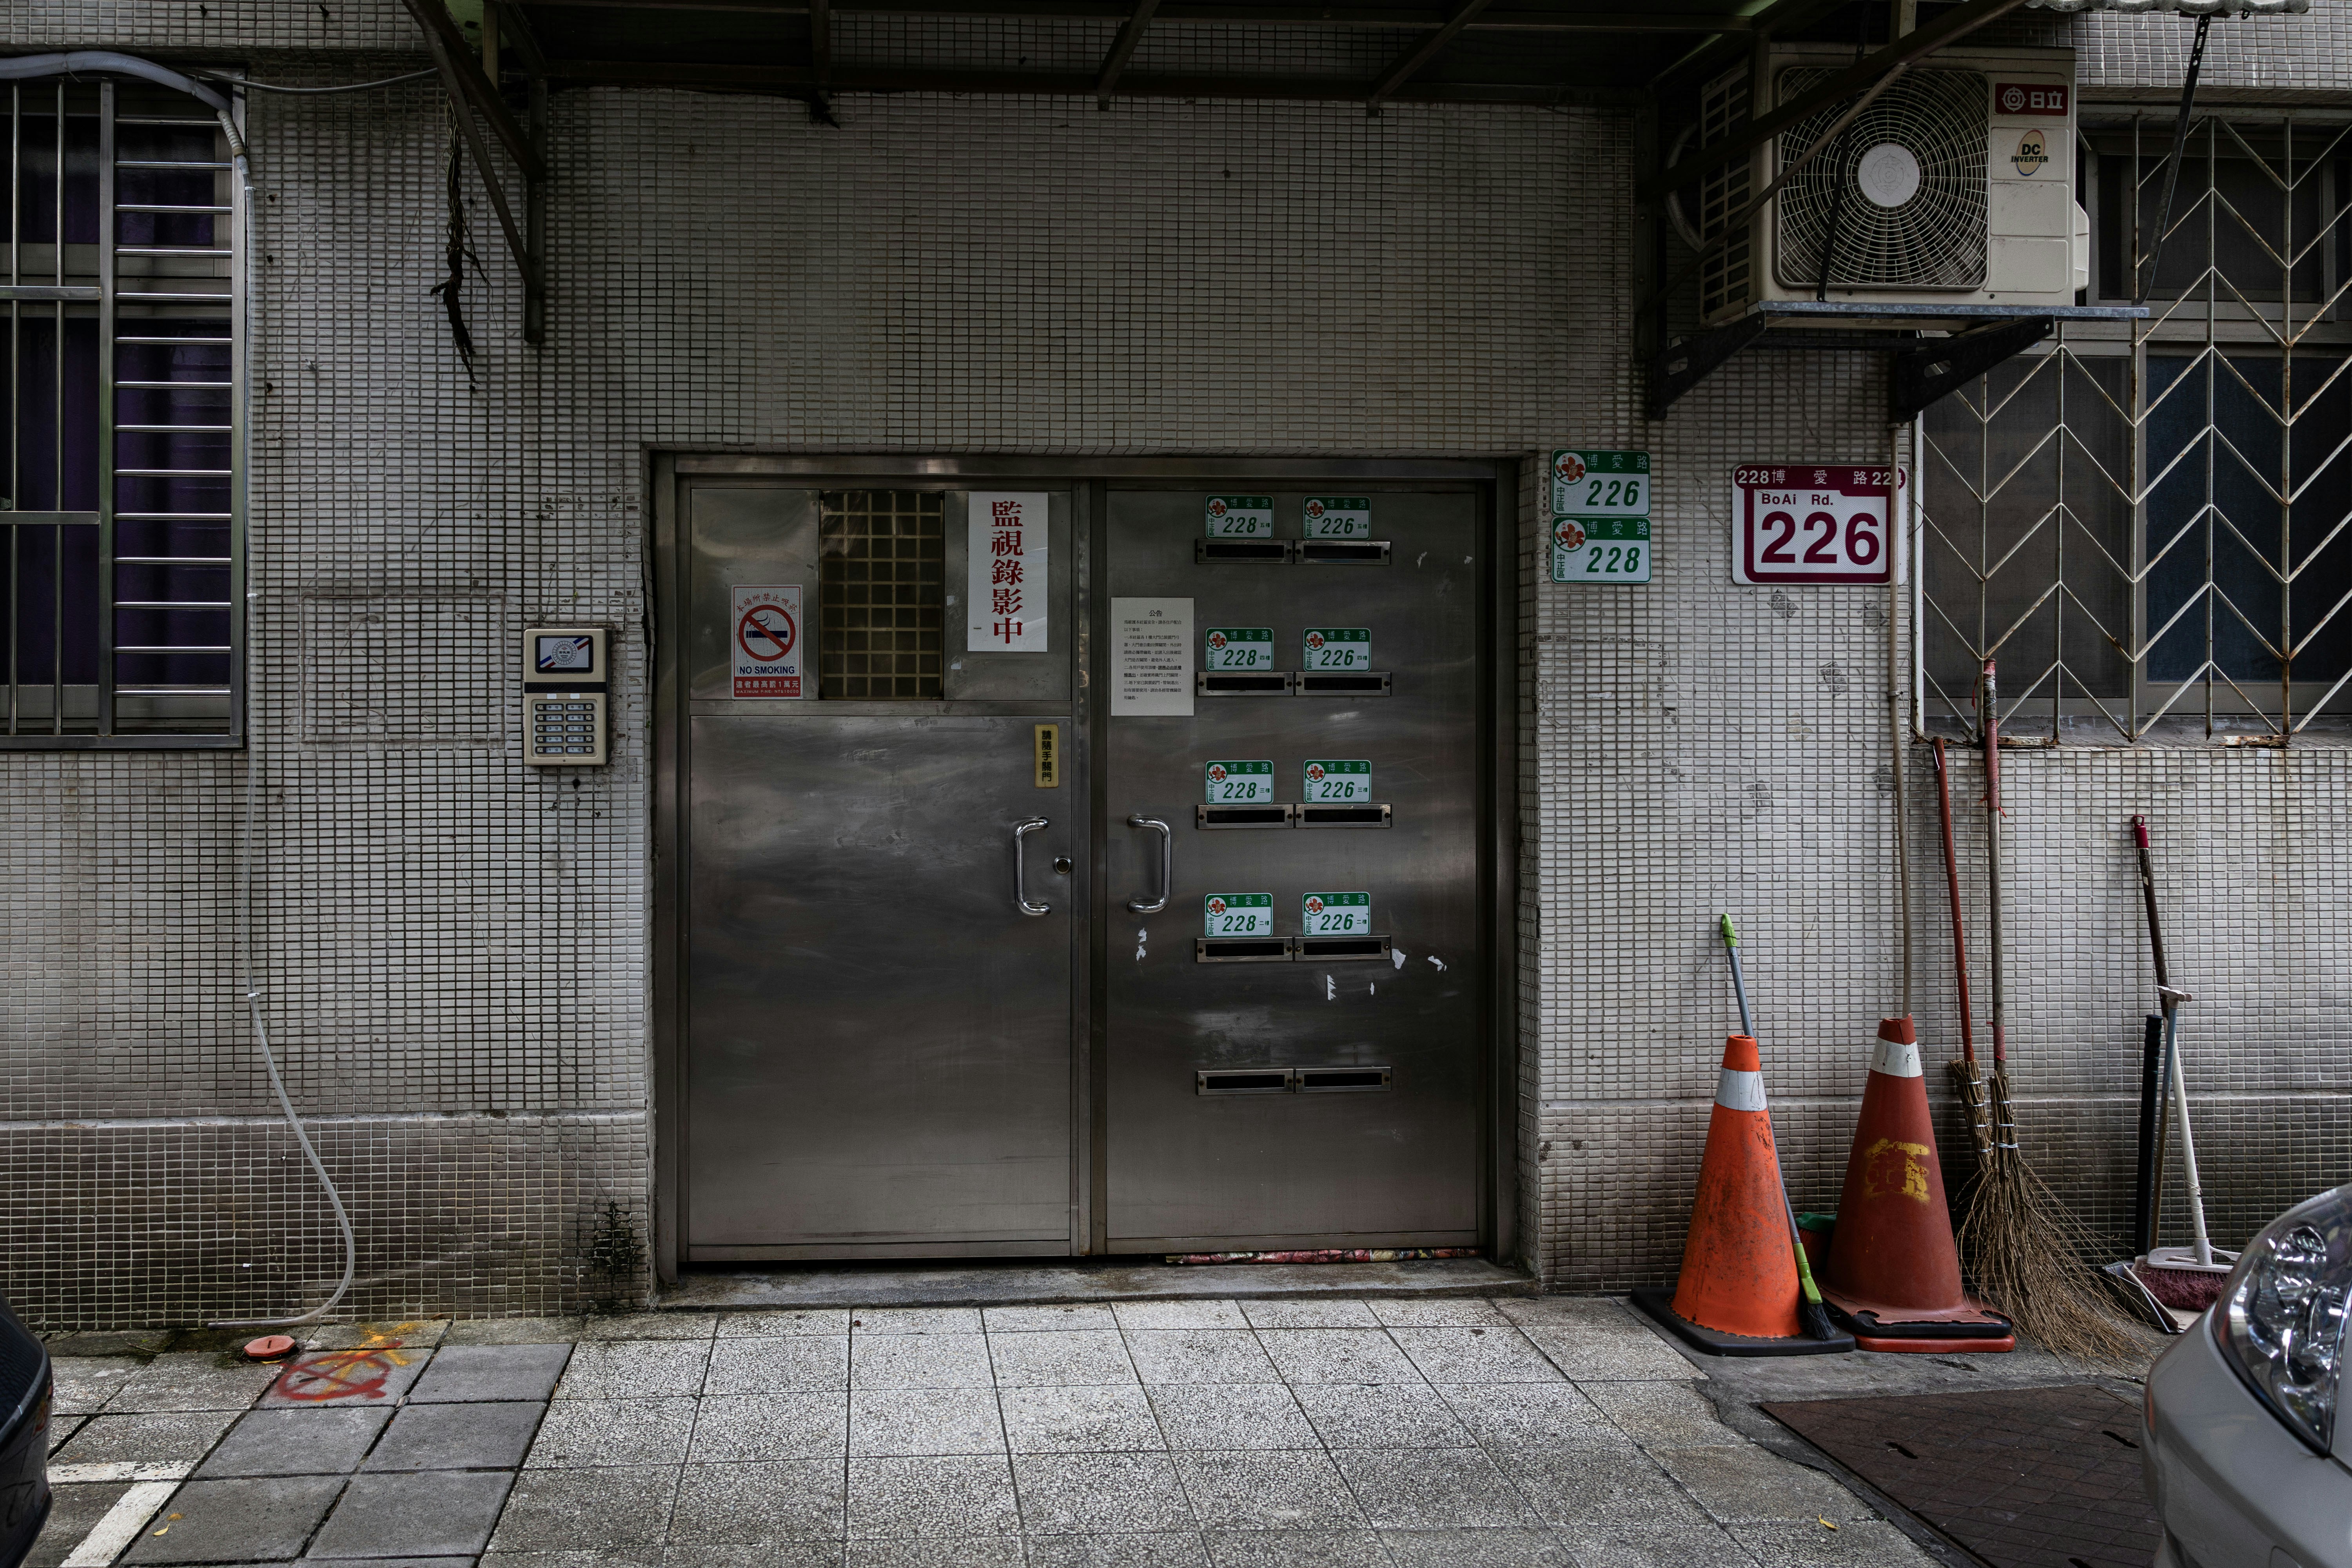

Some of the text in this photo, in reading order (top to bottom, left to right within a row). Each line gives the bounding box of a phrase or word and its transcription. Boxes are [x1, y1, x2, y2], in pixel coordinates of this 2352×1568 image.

[2031, 91, 2062, 109] 日立
[2022, 144, 2040, 155] DC
[1587, 454, 1647, 469] 博愛路
[1739, 470, 1768, 483] 228
[1772, 470, 1867, 484] 博愛路
[1556, 487, 1564, 511] 中正區
[1586, 480, 1639, 506] 226
[1762, 494, 1833, 505] BoAi Rd.
[1231, 499, 1268, 507] 博愛路
[1328, 499, 1365, 508] 博愛路
[1223, 517, 1257, 533] 228
[1320, 518, 1354, 534] 226
[1587, 521, 1647, 535] 博愛路
[1761, 511, 1879, 565] 226
[1586, 547, 1640, 573] 228
[991, 501, 1024, 644] 監視錄影中
[737, 593, 797, 613] 本場所禁止吸菸
[1231, 631, 1268, 640] 博愛路
[1328, 631, 1365, 640] 博愛路
[1223, 650, 1257, 665] 228
[1320, 650, 1354, 666] 226
[755, 666, 794, 674] SMOKING
[1042, 730, 1051, 781] 請隨手關門
[1230, 763, 1268, 772] 博愛路
[1328, 763, 1366, 771] 博愛路
[1223, 782, 1257, 798] 228
[1321, 782, 1354, 797] 226
[1230, 896, 1267, 905] 博愛路
[1327, 895, 1365, 904] 博愛路
[1223, 915, 1256, 931] 228
[1320, 914, 1354, 930] 226
